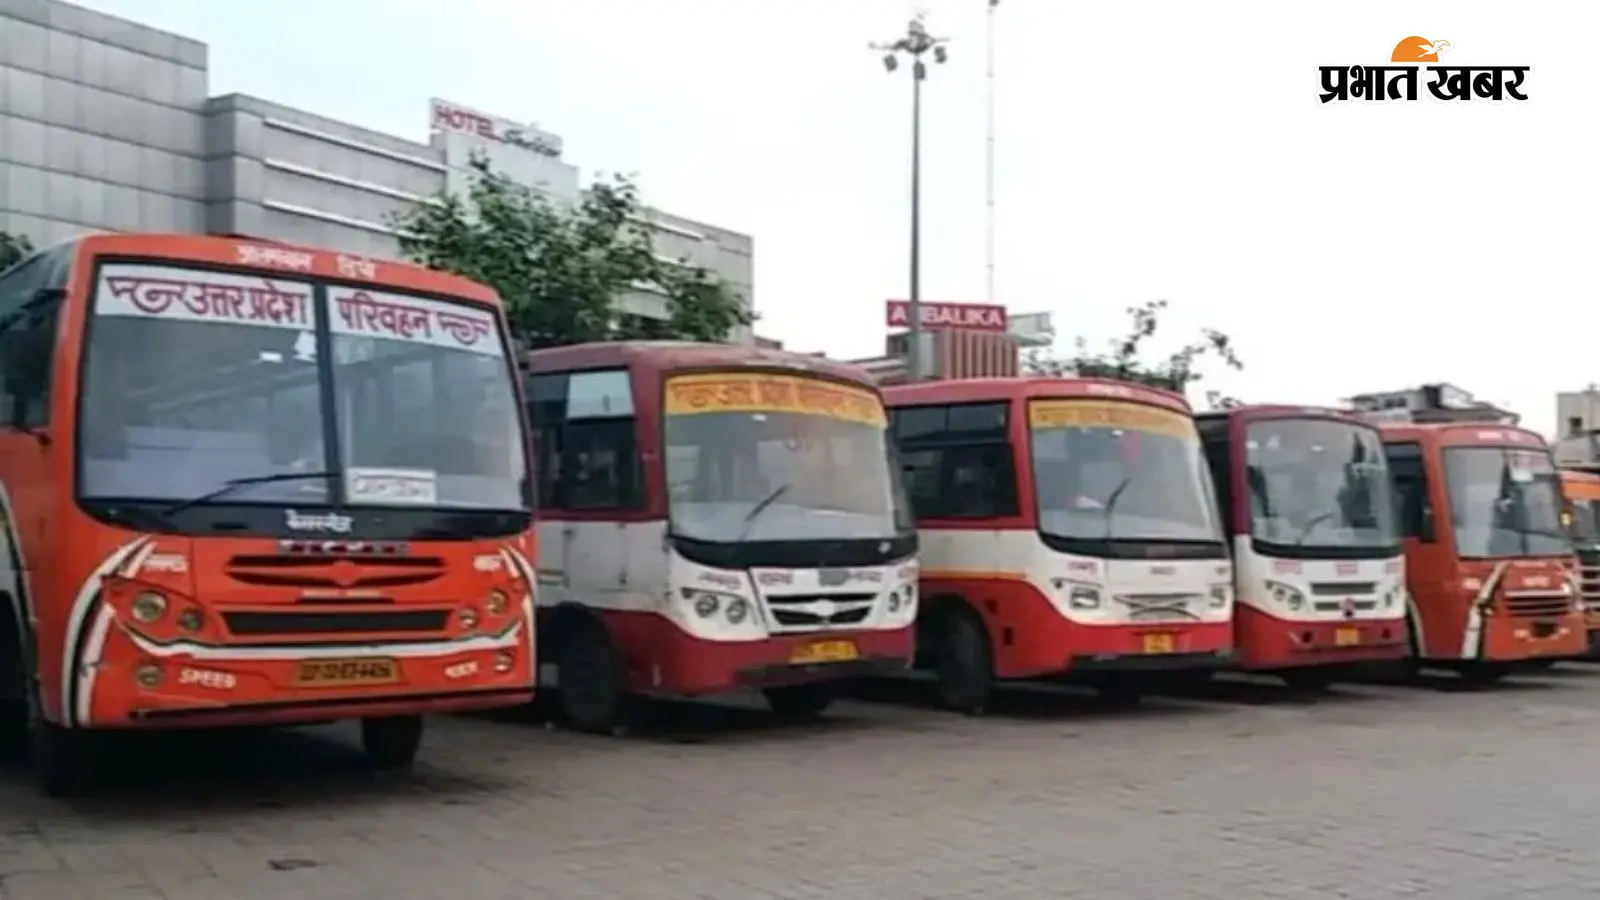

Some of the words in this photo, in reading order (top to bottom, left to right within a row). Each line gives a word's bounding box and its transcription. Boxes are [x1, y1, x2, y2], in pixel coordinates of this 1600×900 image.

[434, 104, 502, 141] HOTEL
[182, 281, 246, 319] उत्तर
[248, 279, 308, 325] प्रदेश
[335, 292, 432, 338] परिवहन
